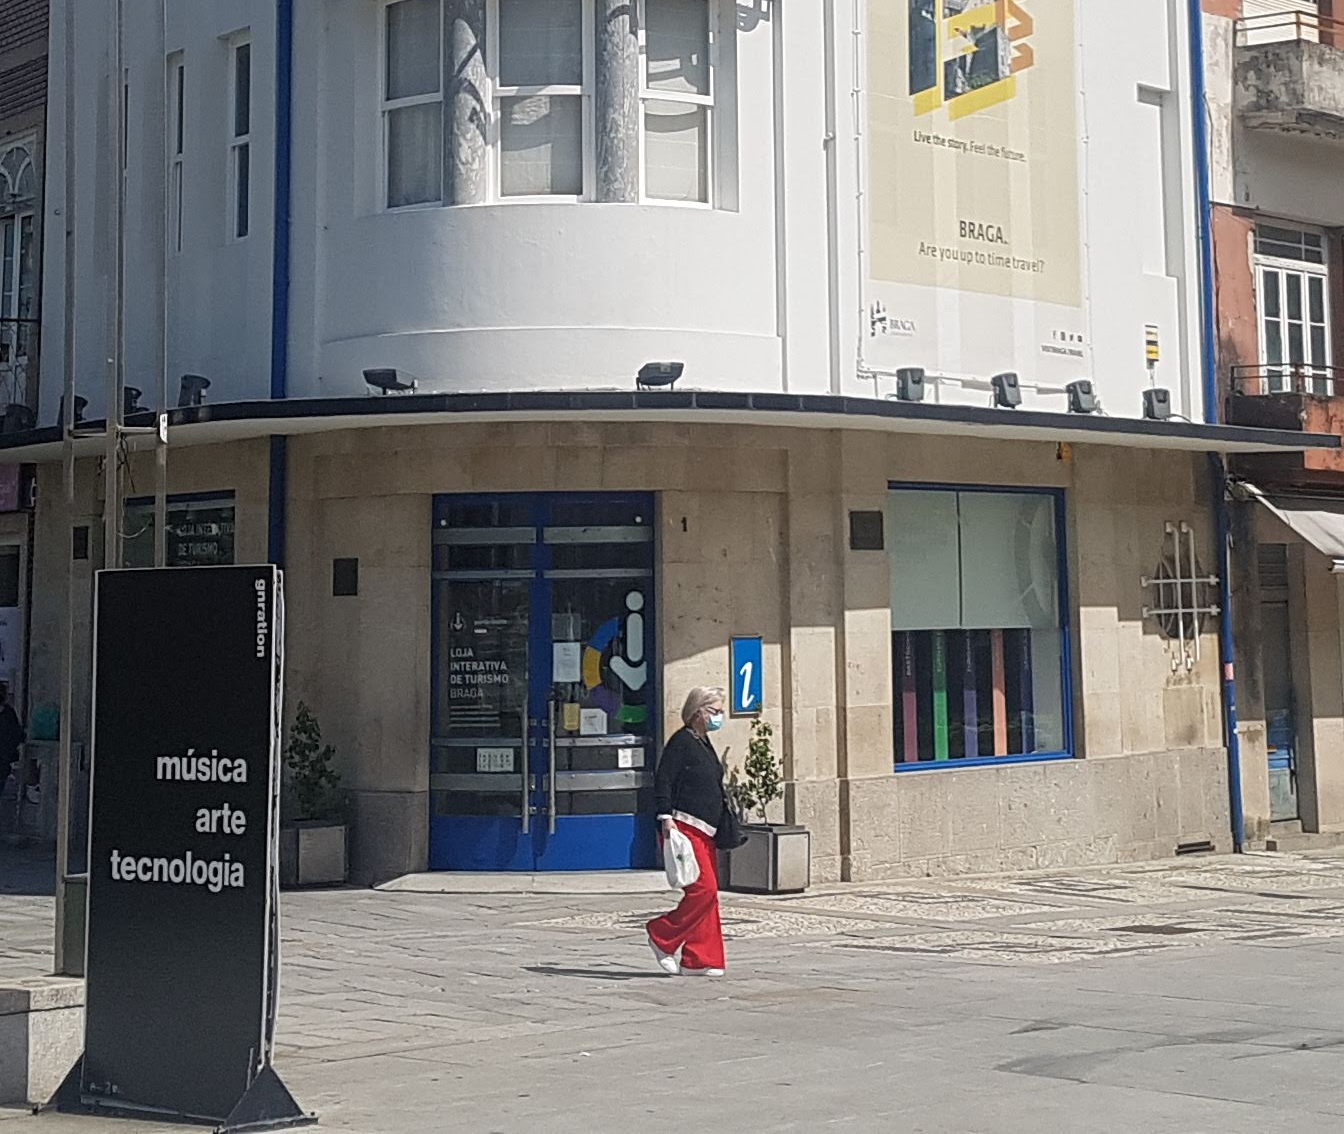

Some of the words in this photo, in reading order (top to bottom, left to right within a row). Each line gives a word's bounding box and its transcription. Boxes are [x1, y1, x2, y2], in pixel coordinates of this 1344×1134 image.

[913, 130, 931, 145] Live
[933, 133, 946, 147] the
[947, 137, 969, 153] story.
[970, 140, 986, 154] Feel
[987, 144, 1000, 157] the
[959, 220, 1009, 245] BRAGA.
[919, 241, 937, 257] Are
[939, 246, 959, 262] you
[960, 250, 974, 265] up
[975, 251, 986, 265] to
[987, 252, 1011, 268] time
[1012, 256, 1045, 274] travel?
[681, 517, 687, 532] 1
[255, 578, 268, 658] gnration
[450, 648, 474, 658] LOJA
[450, 661, 508, 671] INTERATIVA
[450, 674, 463, 684] DE
[465, 674, 509, 684] TURISMO
[450, 688, 484, 699] BRAGA
[156, 749, 247, 783] música
[195, 803, 247, 835] arte
[110, 849, 245, 893] tecnologia
